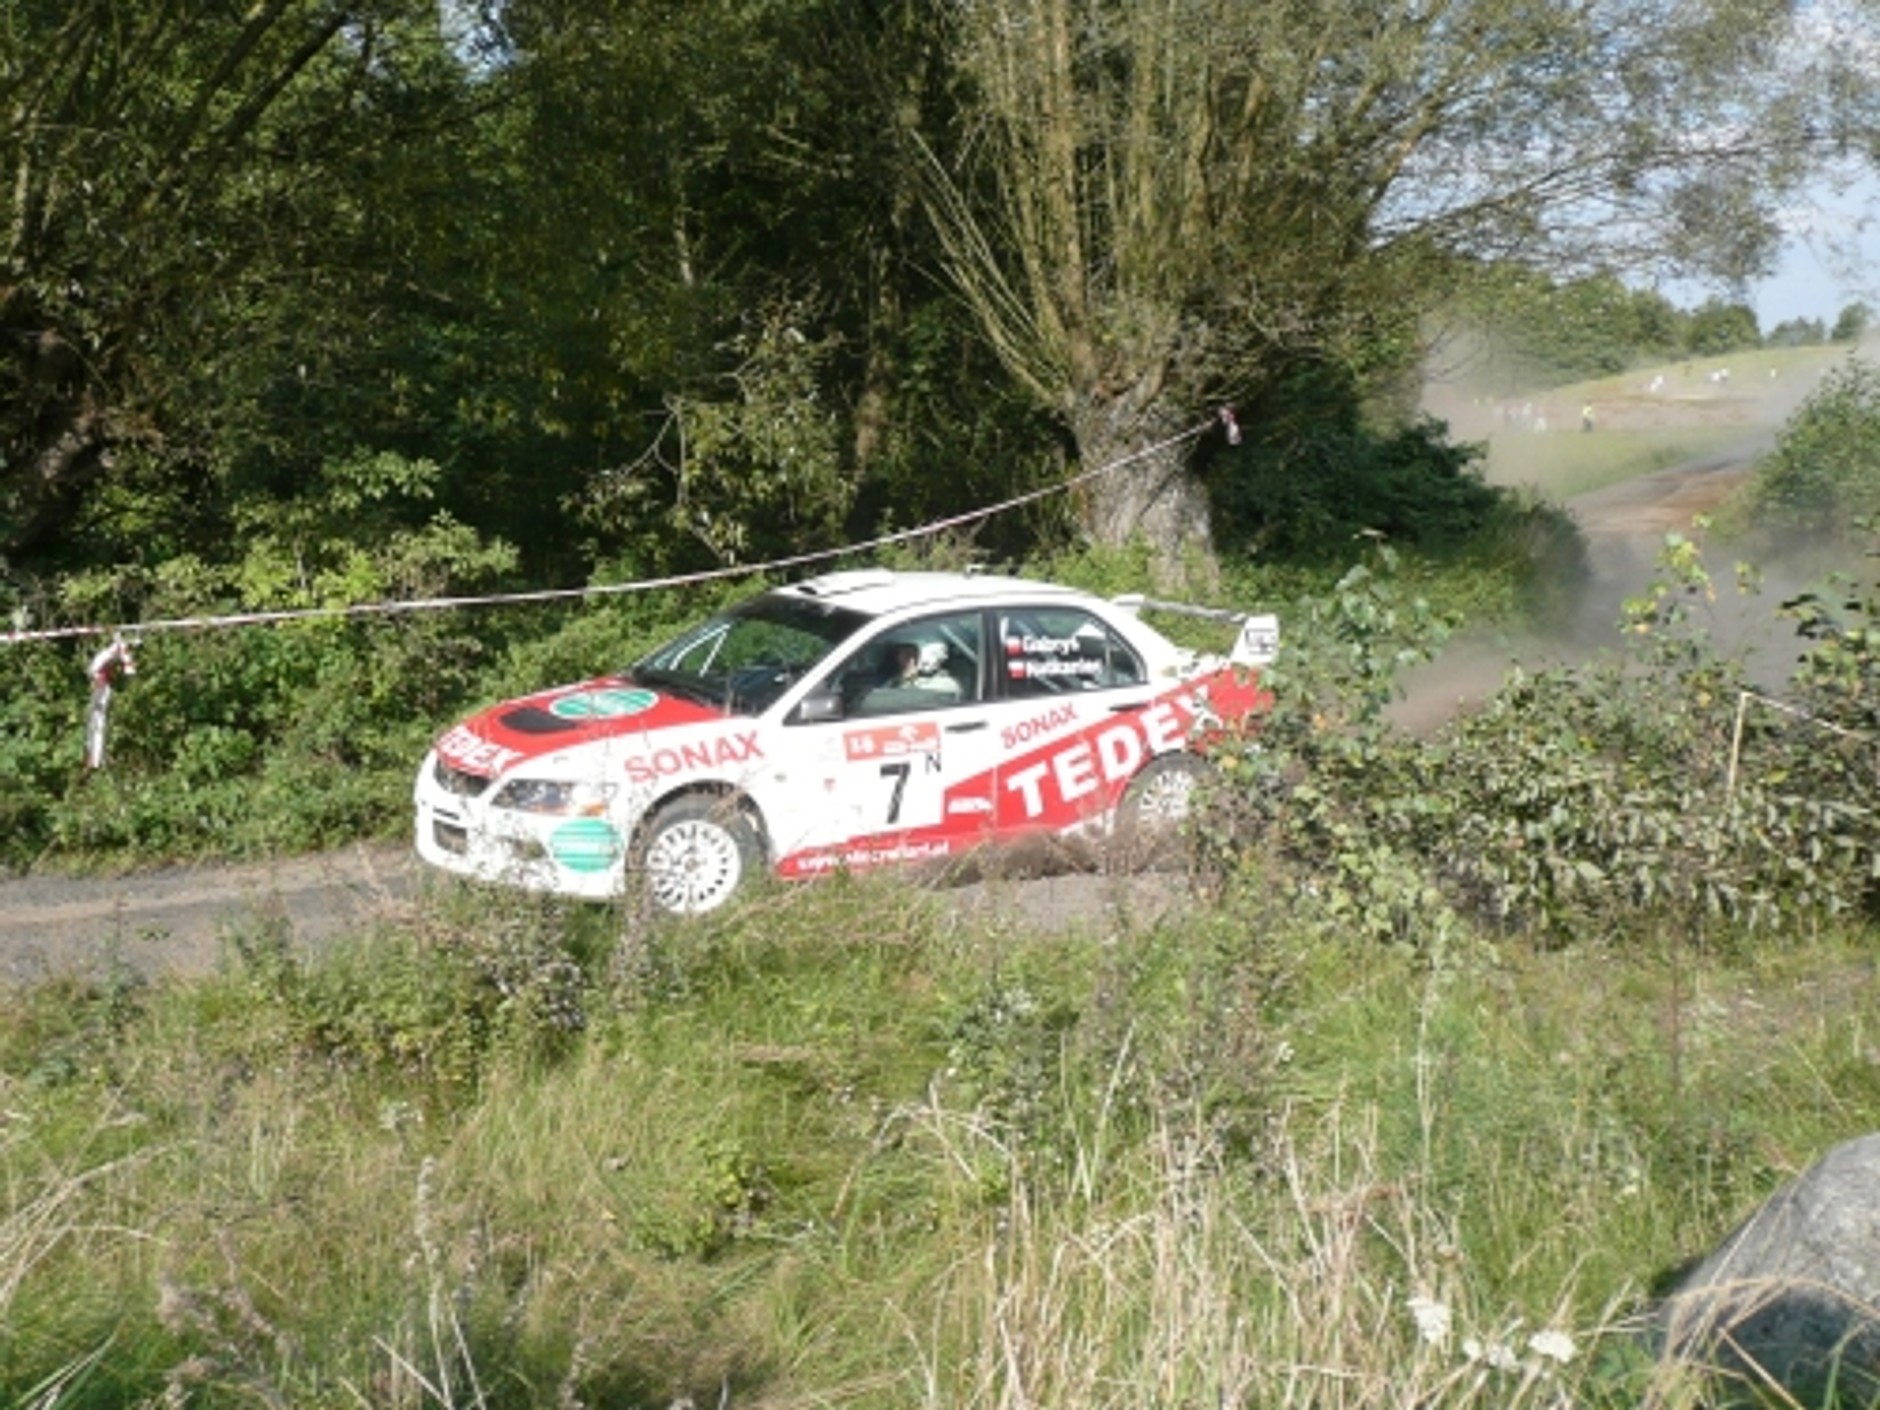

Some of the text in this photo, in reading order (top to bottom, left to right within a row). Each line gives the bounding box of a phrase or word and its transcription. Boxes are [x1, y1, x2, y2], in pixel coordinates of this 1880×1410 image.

[1001, 703, 1078, 749] SONAX
[1006, 684, 1224, 818] TEDEX
[624, 731, 766, 784] SONAX
[925, 752, 942, 774] N
[880, 762, 910, 824] 7
